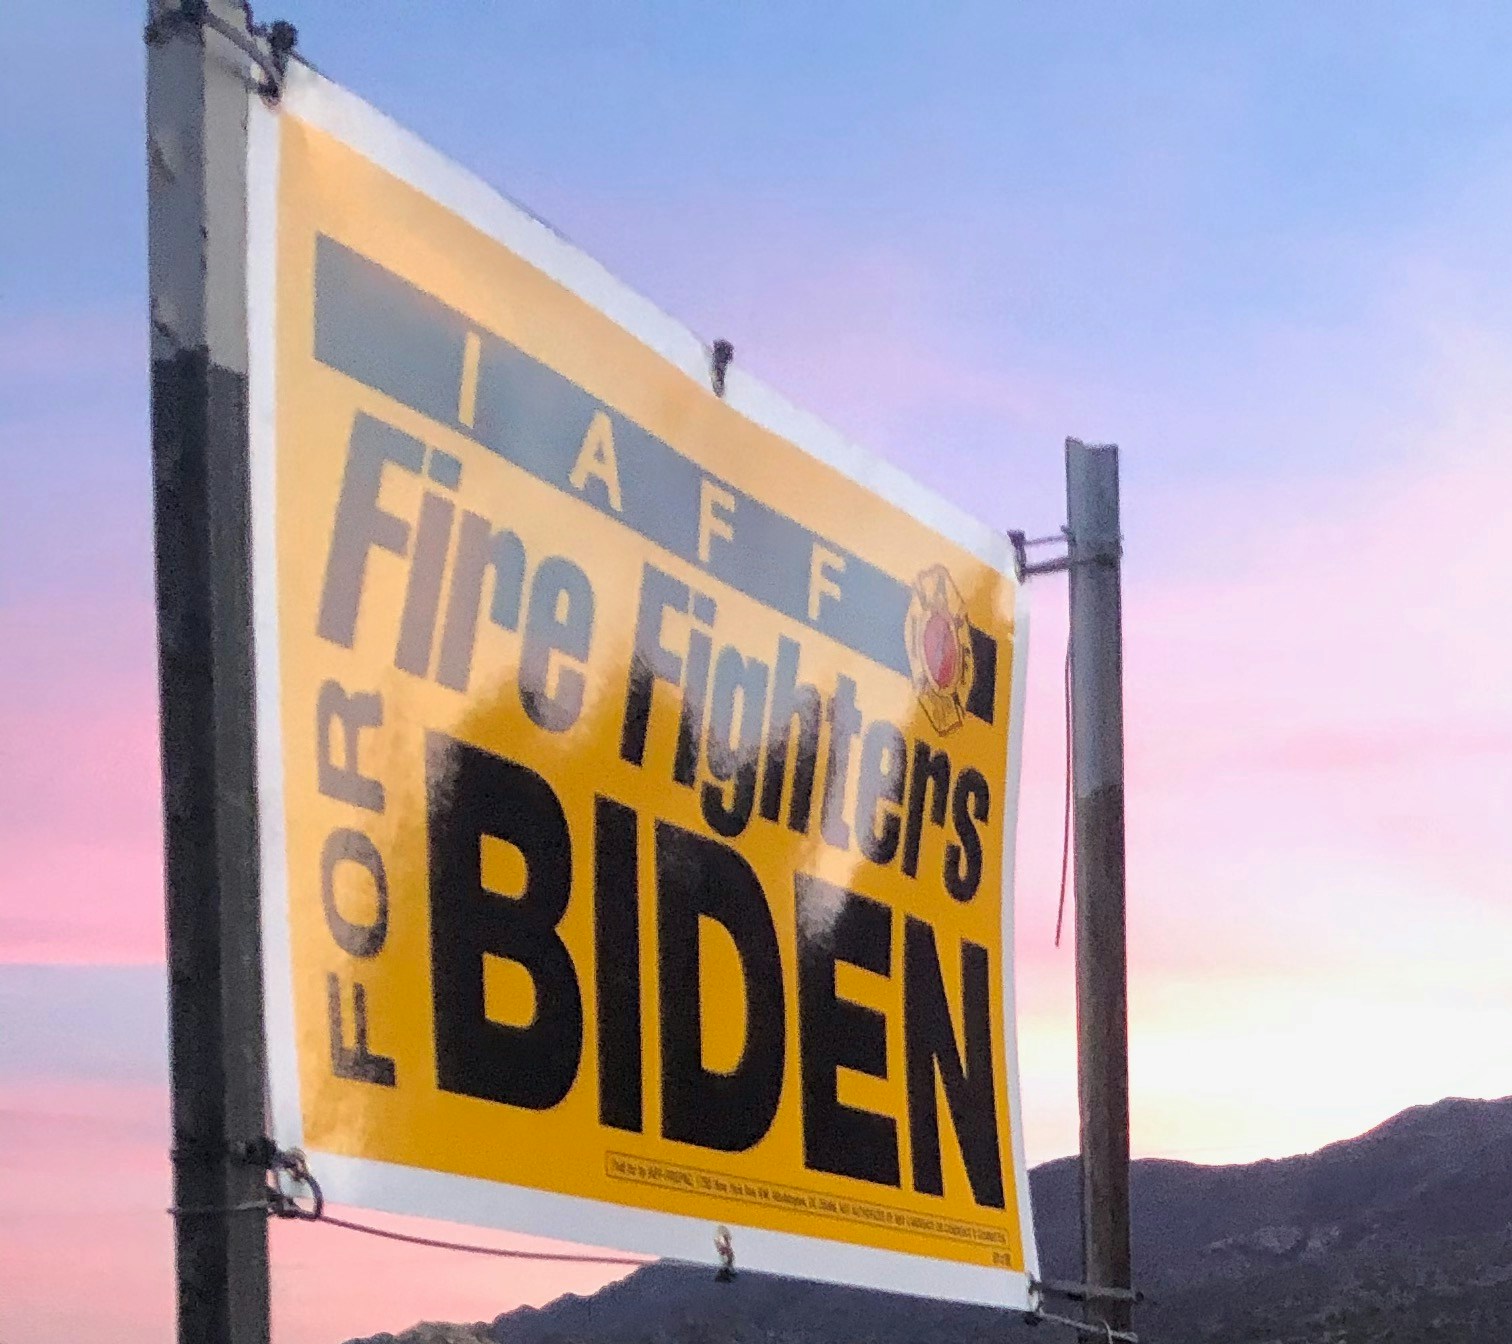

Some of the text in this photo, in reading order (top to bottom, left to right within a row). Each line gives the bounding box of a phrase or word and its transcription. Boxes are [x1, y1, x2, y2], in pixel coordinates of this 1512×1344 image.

[316, 408, 990, 904] Fire Fighters
[316, 677, 398, 1088] FOR
[424, 729, 1006, 1210] BIDEN
